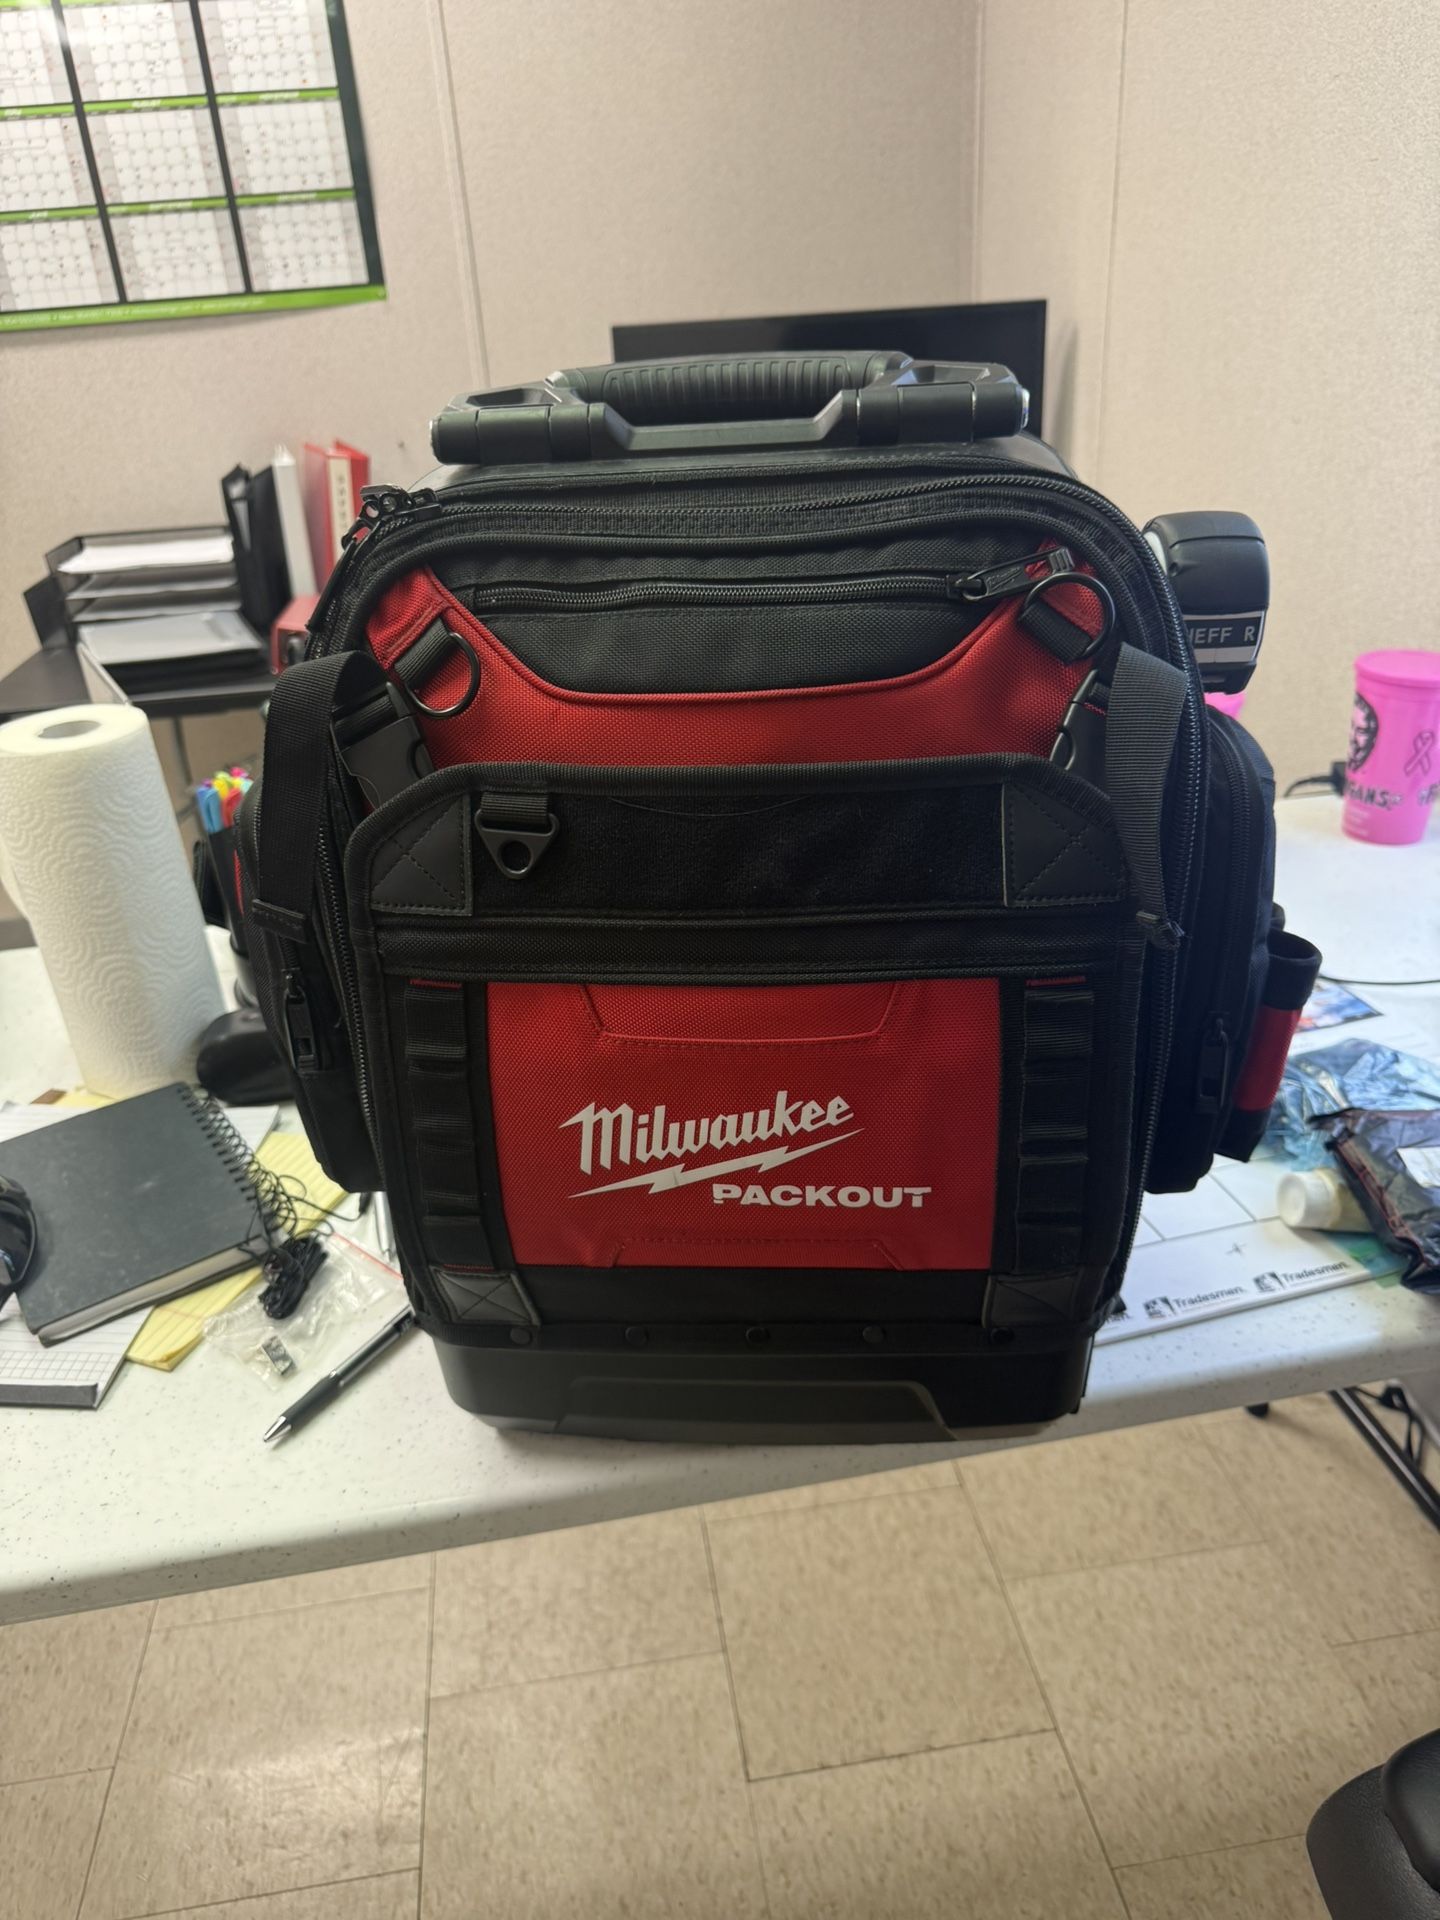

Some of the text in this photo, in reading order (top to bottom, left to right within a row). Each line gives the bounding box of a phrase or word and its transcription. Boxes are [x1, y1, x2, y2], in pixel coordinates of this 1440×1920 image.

[1243, 625, 1256, 642] R
[558, 1090, 855, 1176] Milwaukee
[712, 1183, 932, 1208] PACKOUT
